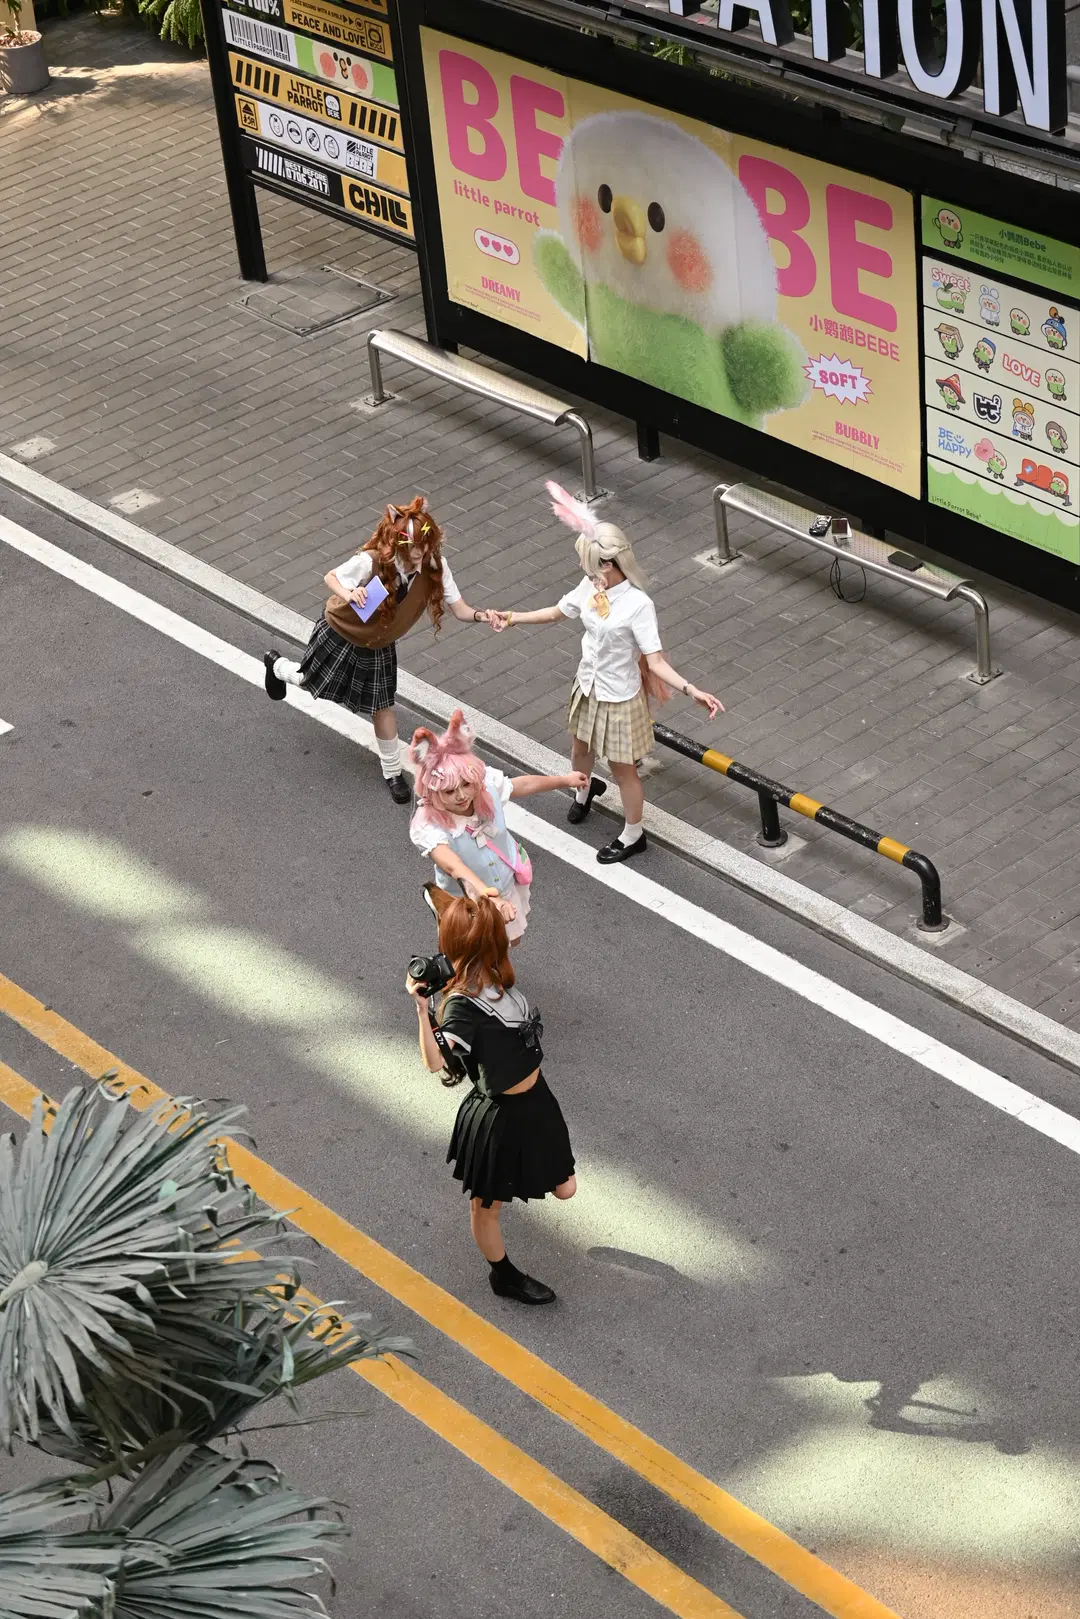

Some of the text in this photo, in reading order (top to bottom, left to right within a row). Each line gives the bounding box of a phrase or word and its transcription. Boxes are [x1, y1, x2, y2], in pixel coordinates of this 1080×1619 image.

[292, 11, 367, 48] PEACE AND LOVE
[234, 36, 289, 62] LITTLE PARROT BEBE
[287, 90, 324, 115] PARROT
[290, 79, 323, 101] LITTLE
[355, 143, 374, 156] LITTLE
[355, 149, 374, 161] PARROT
[302, 166, 328, 183] BEFORE
[347, 153, 373, 175] BEBE
[439, 49, 898, 333] BE BE
[453, 179, 541, 227] little parrot
[348, 183, 408, 230] CHILL
[481, 275, 521, 303] DREAMY
[809, 314, 900, 361] 小鹦鹉BEBE
[818, 369, 858, 391] SOFT
[1002, 353, 1041, 387] LOVE
[835, 421, 880, 450] BUBBLY
[938, 427, 953, 441] BE
[938, 439, 972, 459] HAPPY
[931, 495, 947, 506] Little
